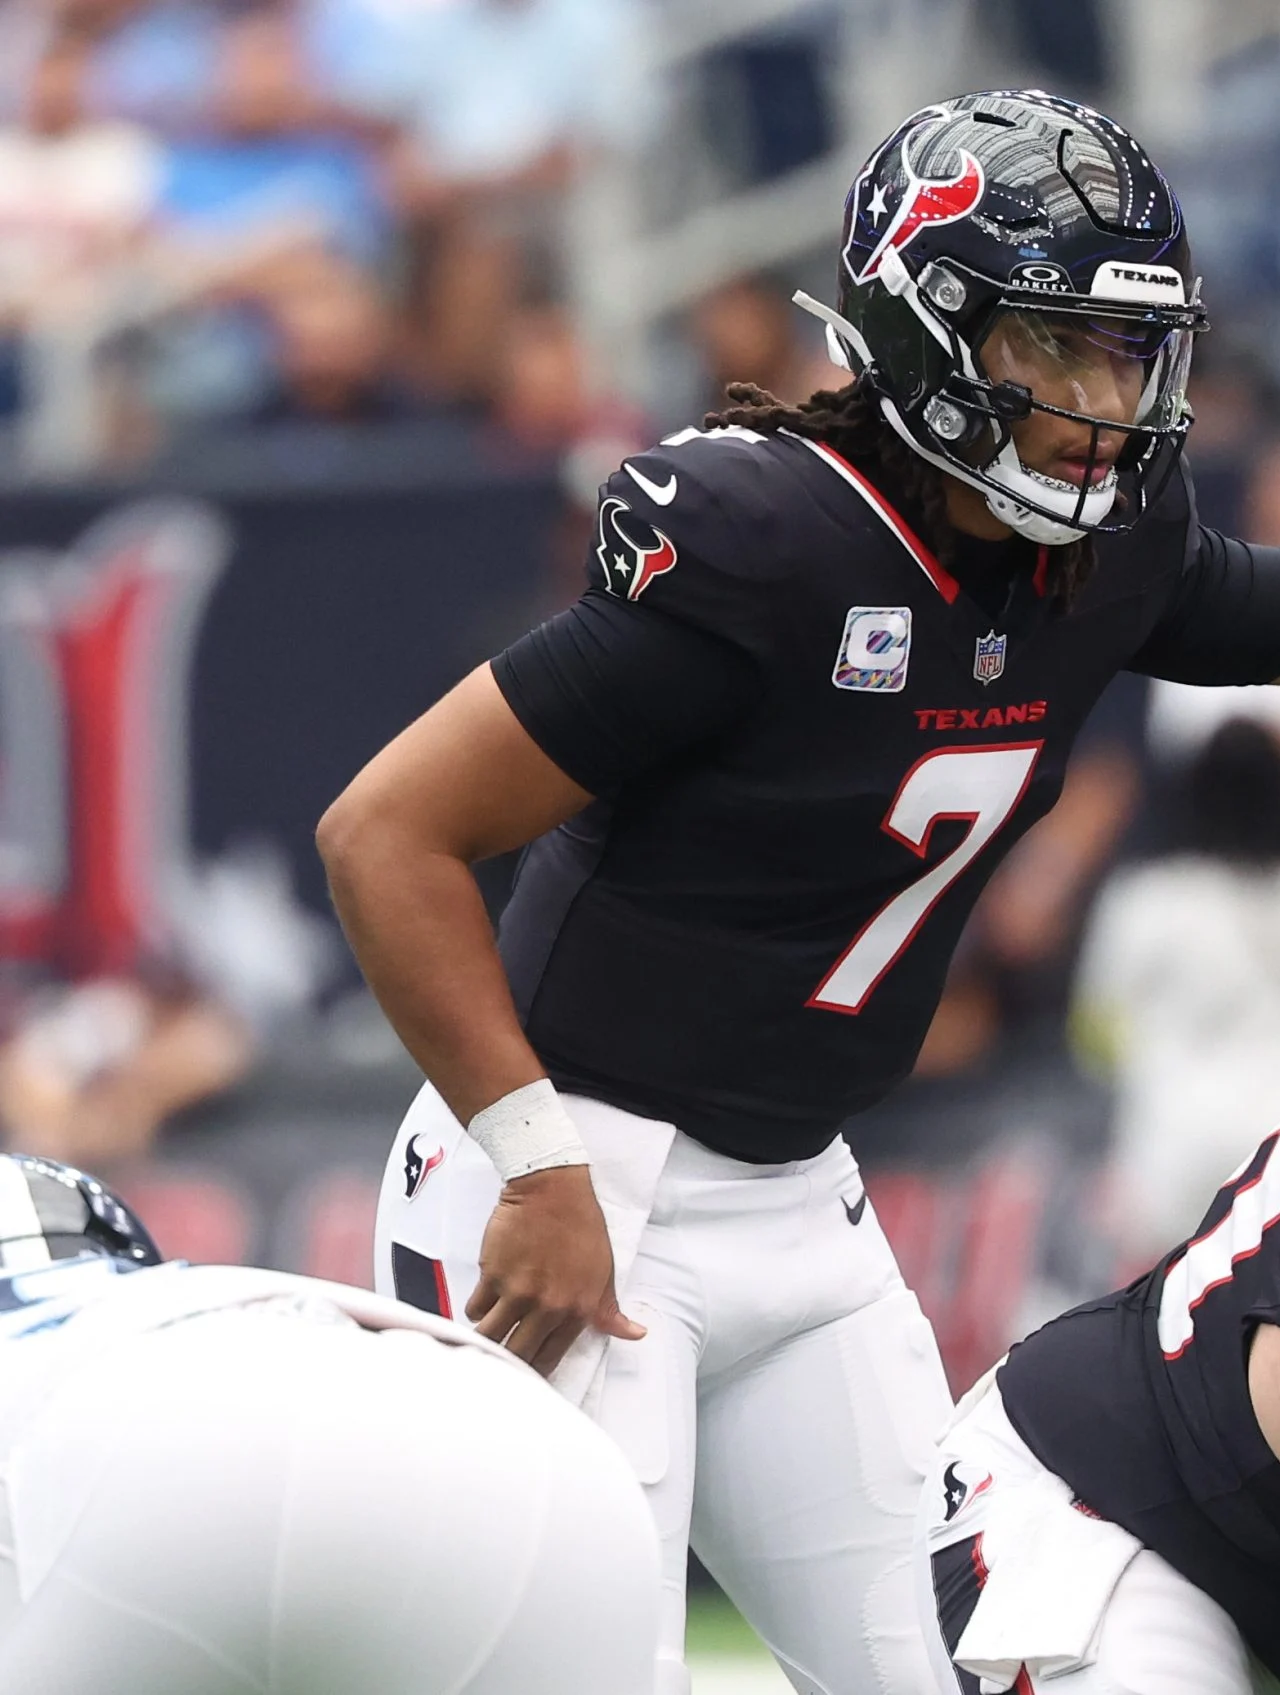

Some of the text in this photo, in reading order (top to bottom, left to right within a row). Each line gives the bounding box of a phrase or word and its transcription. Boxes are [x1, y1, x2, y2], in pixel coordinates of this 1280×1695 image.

[1012, 279, 1070, 292] OAKLEY
[1110, 268, 1179, 287] TEXANS
[846, 613, 907, 671] C
[978, 655, 1000, 675] NFL
[913, 700, 1048, 730] TEXANS
[804, 738, 1046, 1016] 7
